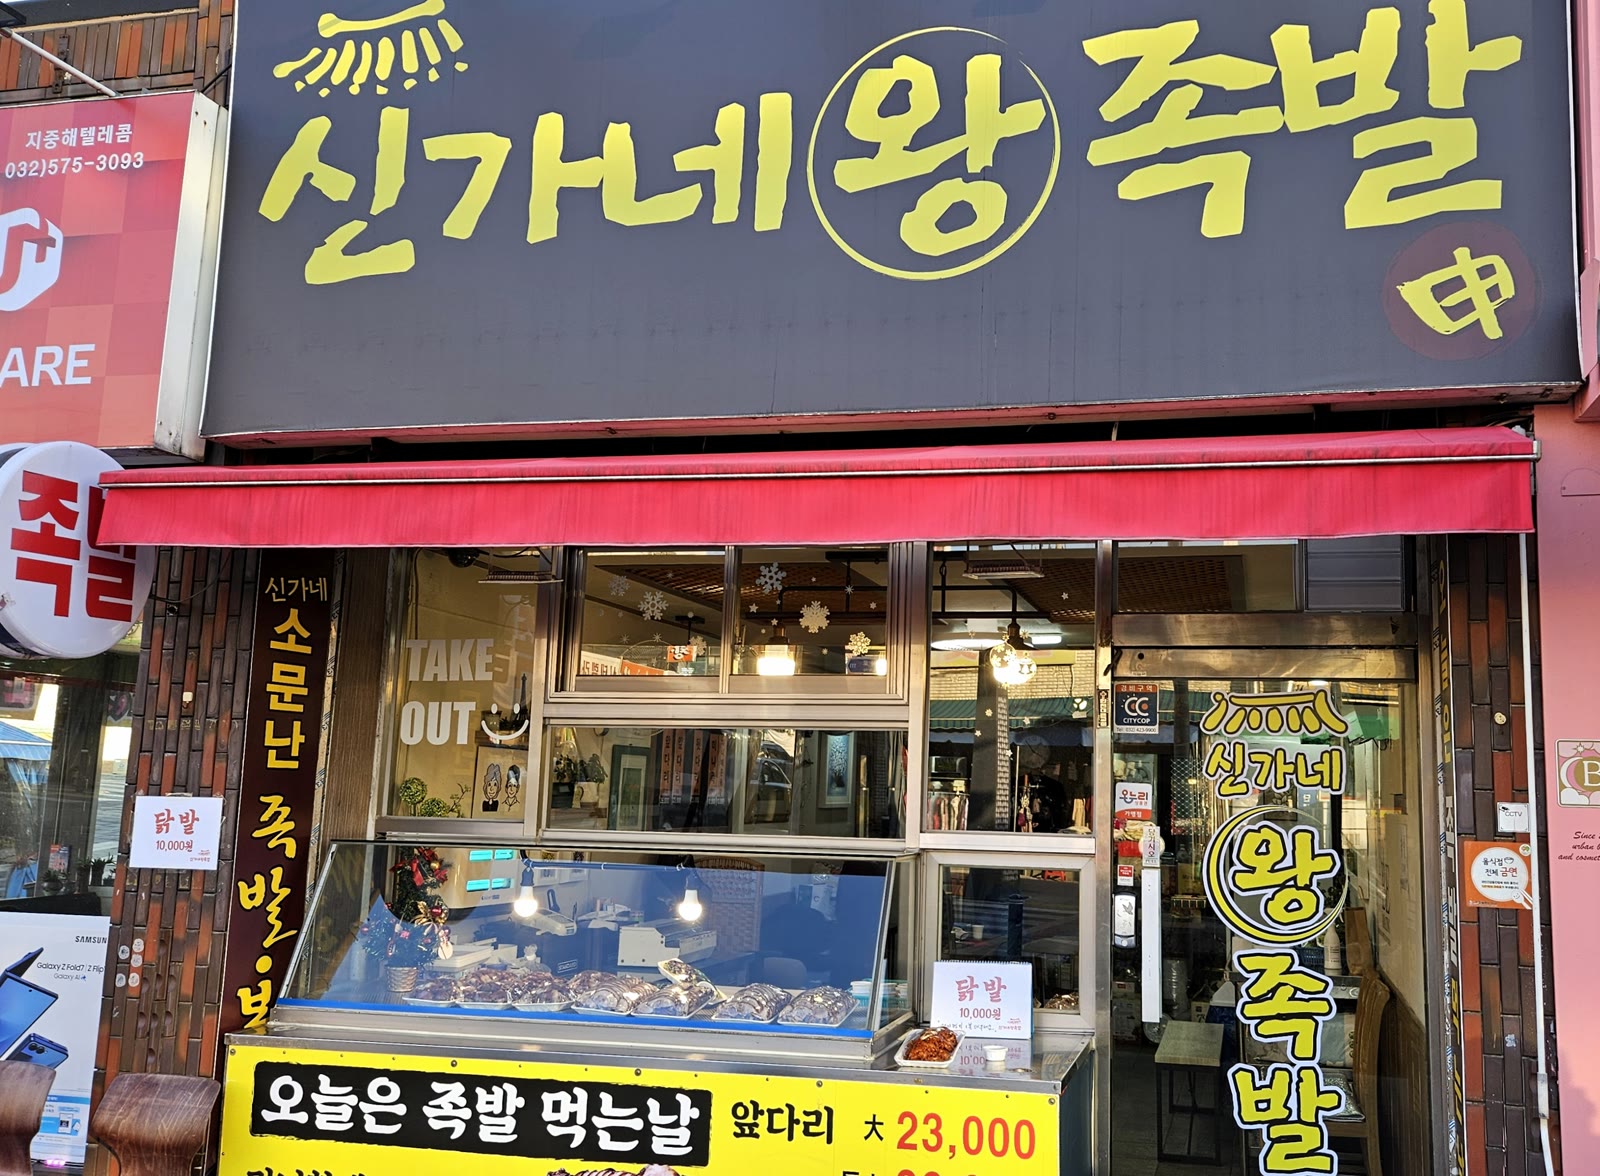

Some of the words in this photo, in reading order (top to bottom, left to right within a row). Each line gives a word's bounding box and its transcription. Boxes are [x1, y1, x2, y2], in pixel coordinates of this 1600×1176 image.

[25, 123, 133, 149] 지중해텔레콤
[258, 91, 792, 284] 신가네
[833, 53, 1047, 257] 왕
[1083, 0, 1523, 237] 족발
[5, 151, 144, 179] 032)575-3093
[264, 577, 327, 602] 신가네
[406, 638, 494, 682] TAKE
[265, 608, 312, 769] 소문난
[400, 701, 476, 746] OUT
[1205, 742, 1343, 796] 신가네
[156, 840, 193, 853] 10,000원
[1572, 842, 1595, 850] urban
[1573, 831, 1596, 840] Since
[1558, 853, 1574, 861] and
[1232, 825, 1337, 926] 왕
[1500, 866, 1518, 878] 금연
[37, 962, 61, 971] Galaxy
[66, 963, 85, 971] Fold7
[87, 964, 92, 972] Z
[960, 1007, 1001, 1021] 10,000원
[1233, 955, 1342, 1172] 족발
[261, 1073, 407, 1135] 오늘은
[422, 1081, 526, 1143] 족발
[541, 1086, 700, 1156] 먹는날
[731, 1099, 834, 1145] 앞다리
[863, 1114, 885, 1142] 大
[897, 1111, 1036, 1160] 23,000
